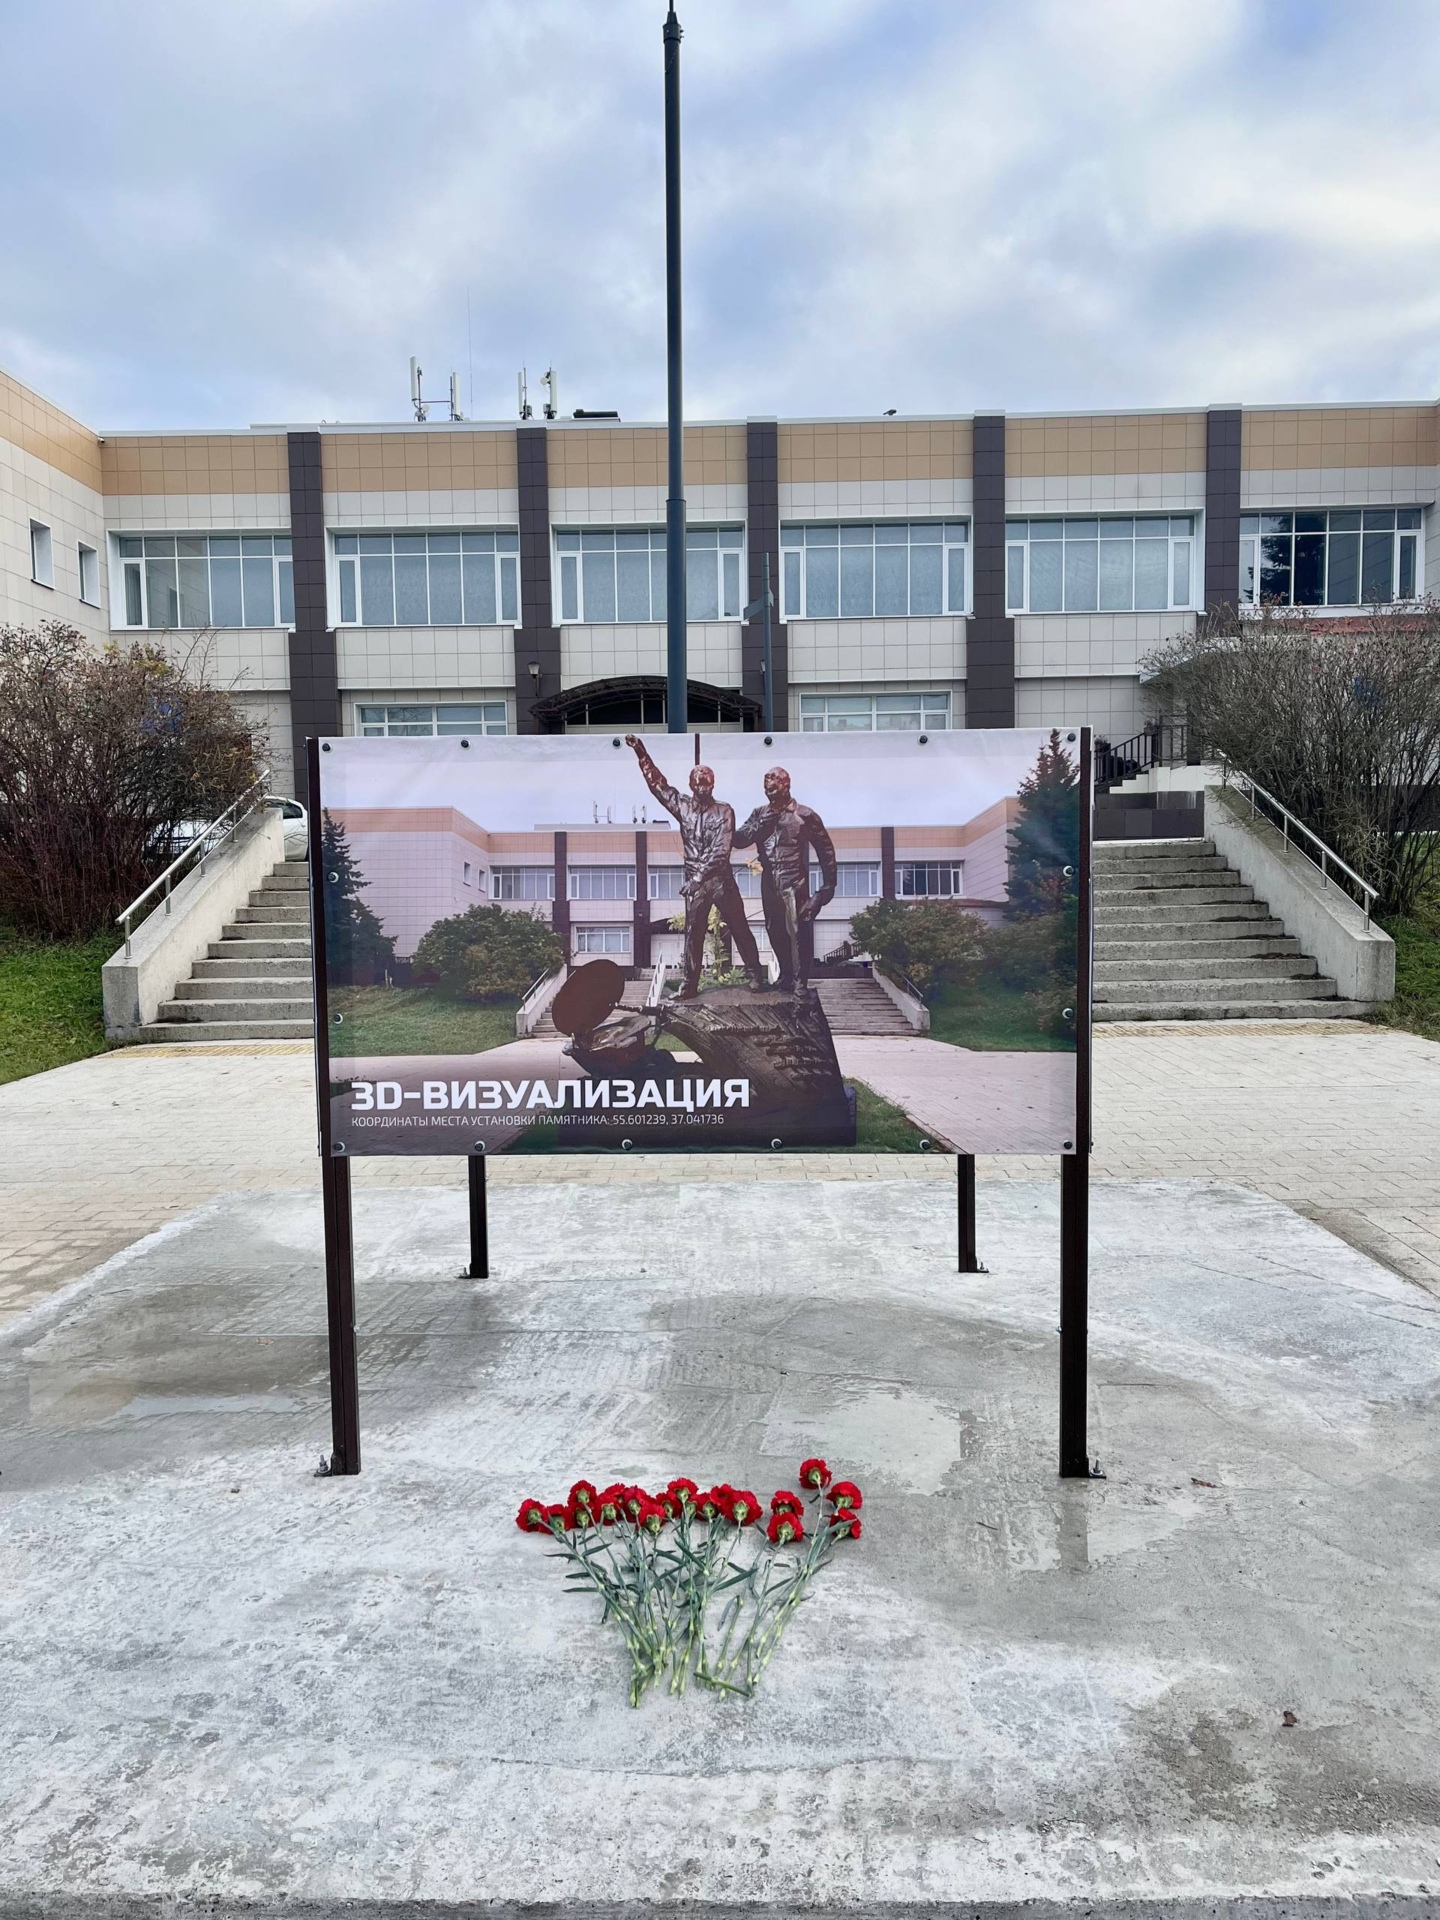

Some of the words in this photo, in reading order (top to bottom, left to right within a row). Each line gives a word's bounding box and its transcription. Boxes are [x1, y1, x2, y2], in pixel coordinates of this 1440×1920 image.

[351, 1078, 750, 1112] 3D-ВИЗУАЛИЗАЦИЯ
[351, 1116, 429, 1128] КООРДИНАТЫ
[431, 1115, 469, 1126] МЕСТА
[471, 1115, 536, 1126] УСТАНОВКИ
[538, 1114, 610, 1126] ПАМЯТНИКА:
[612, 1114, 669, 1126] 55.601239,
[670, 1113, 725, 1125] 37.041736
